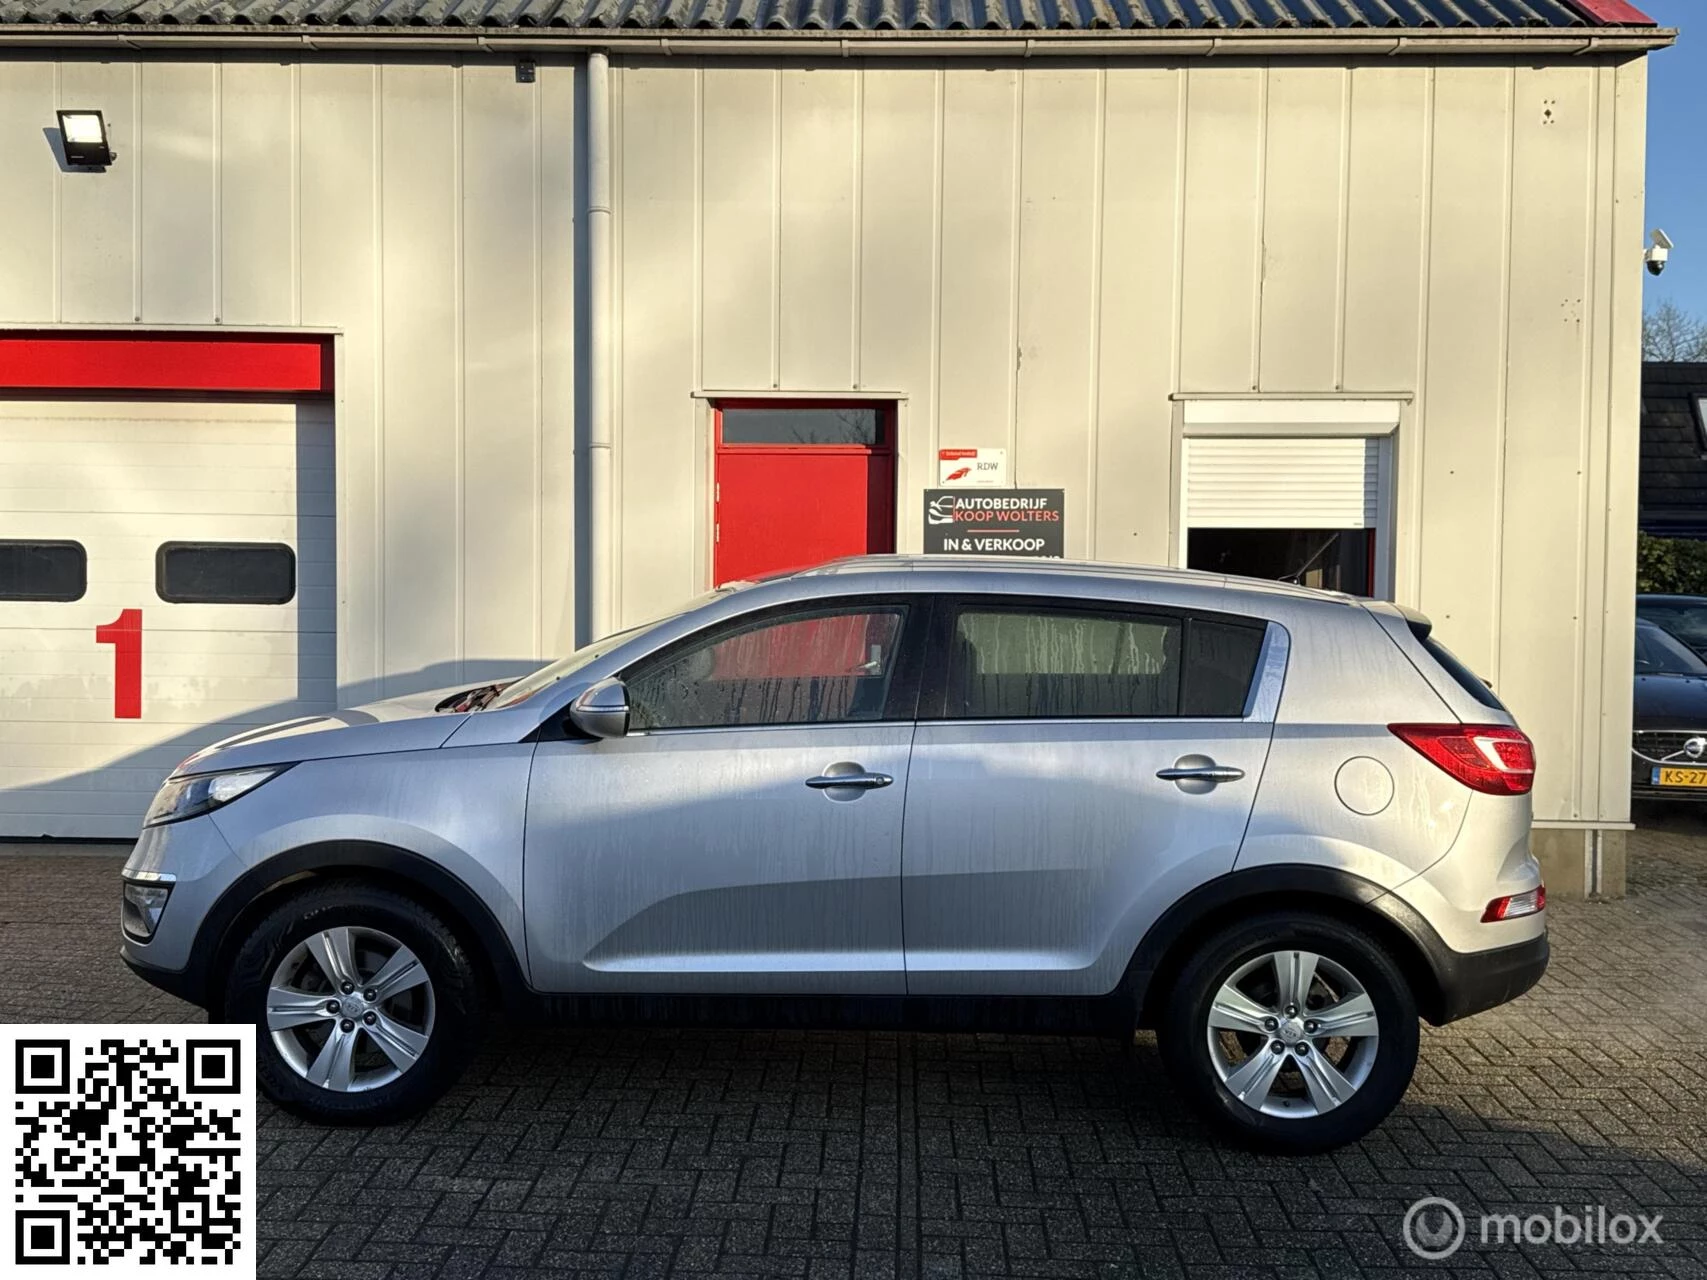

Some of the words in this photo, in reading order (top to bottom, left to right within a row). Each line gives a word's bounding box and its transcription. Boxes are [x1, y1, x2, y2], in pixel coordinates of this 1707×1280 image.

[976, 462, 999, 471] RDW
[955, 498, 1048, 510] AUTOBEDRIJF
[954, 510, 994, 522] KOOP
[997, 510, 1060, 522] WOLTERS
[943, 538, 960, 551] IN
[961, 538, 972, 551] &
[974, 538, 1046, 551] VERKOOP
[96, 608, 143, 719] 1
